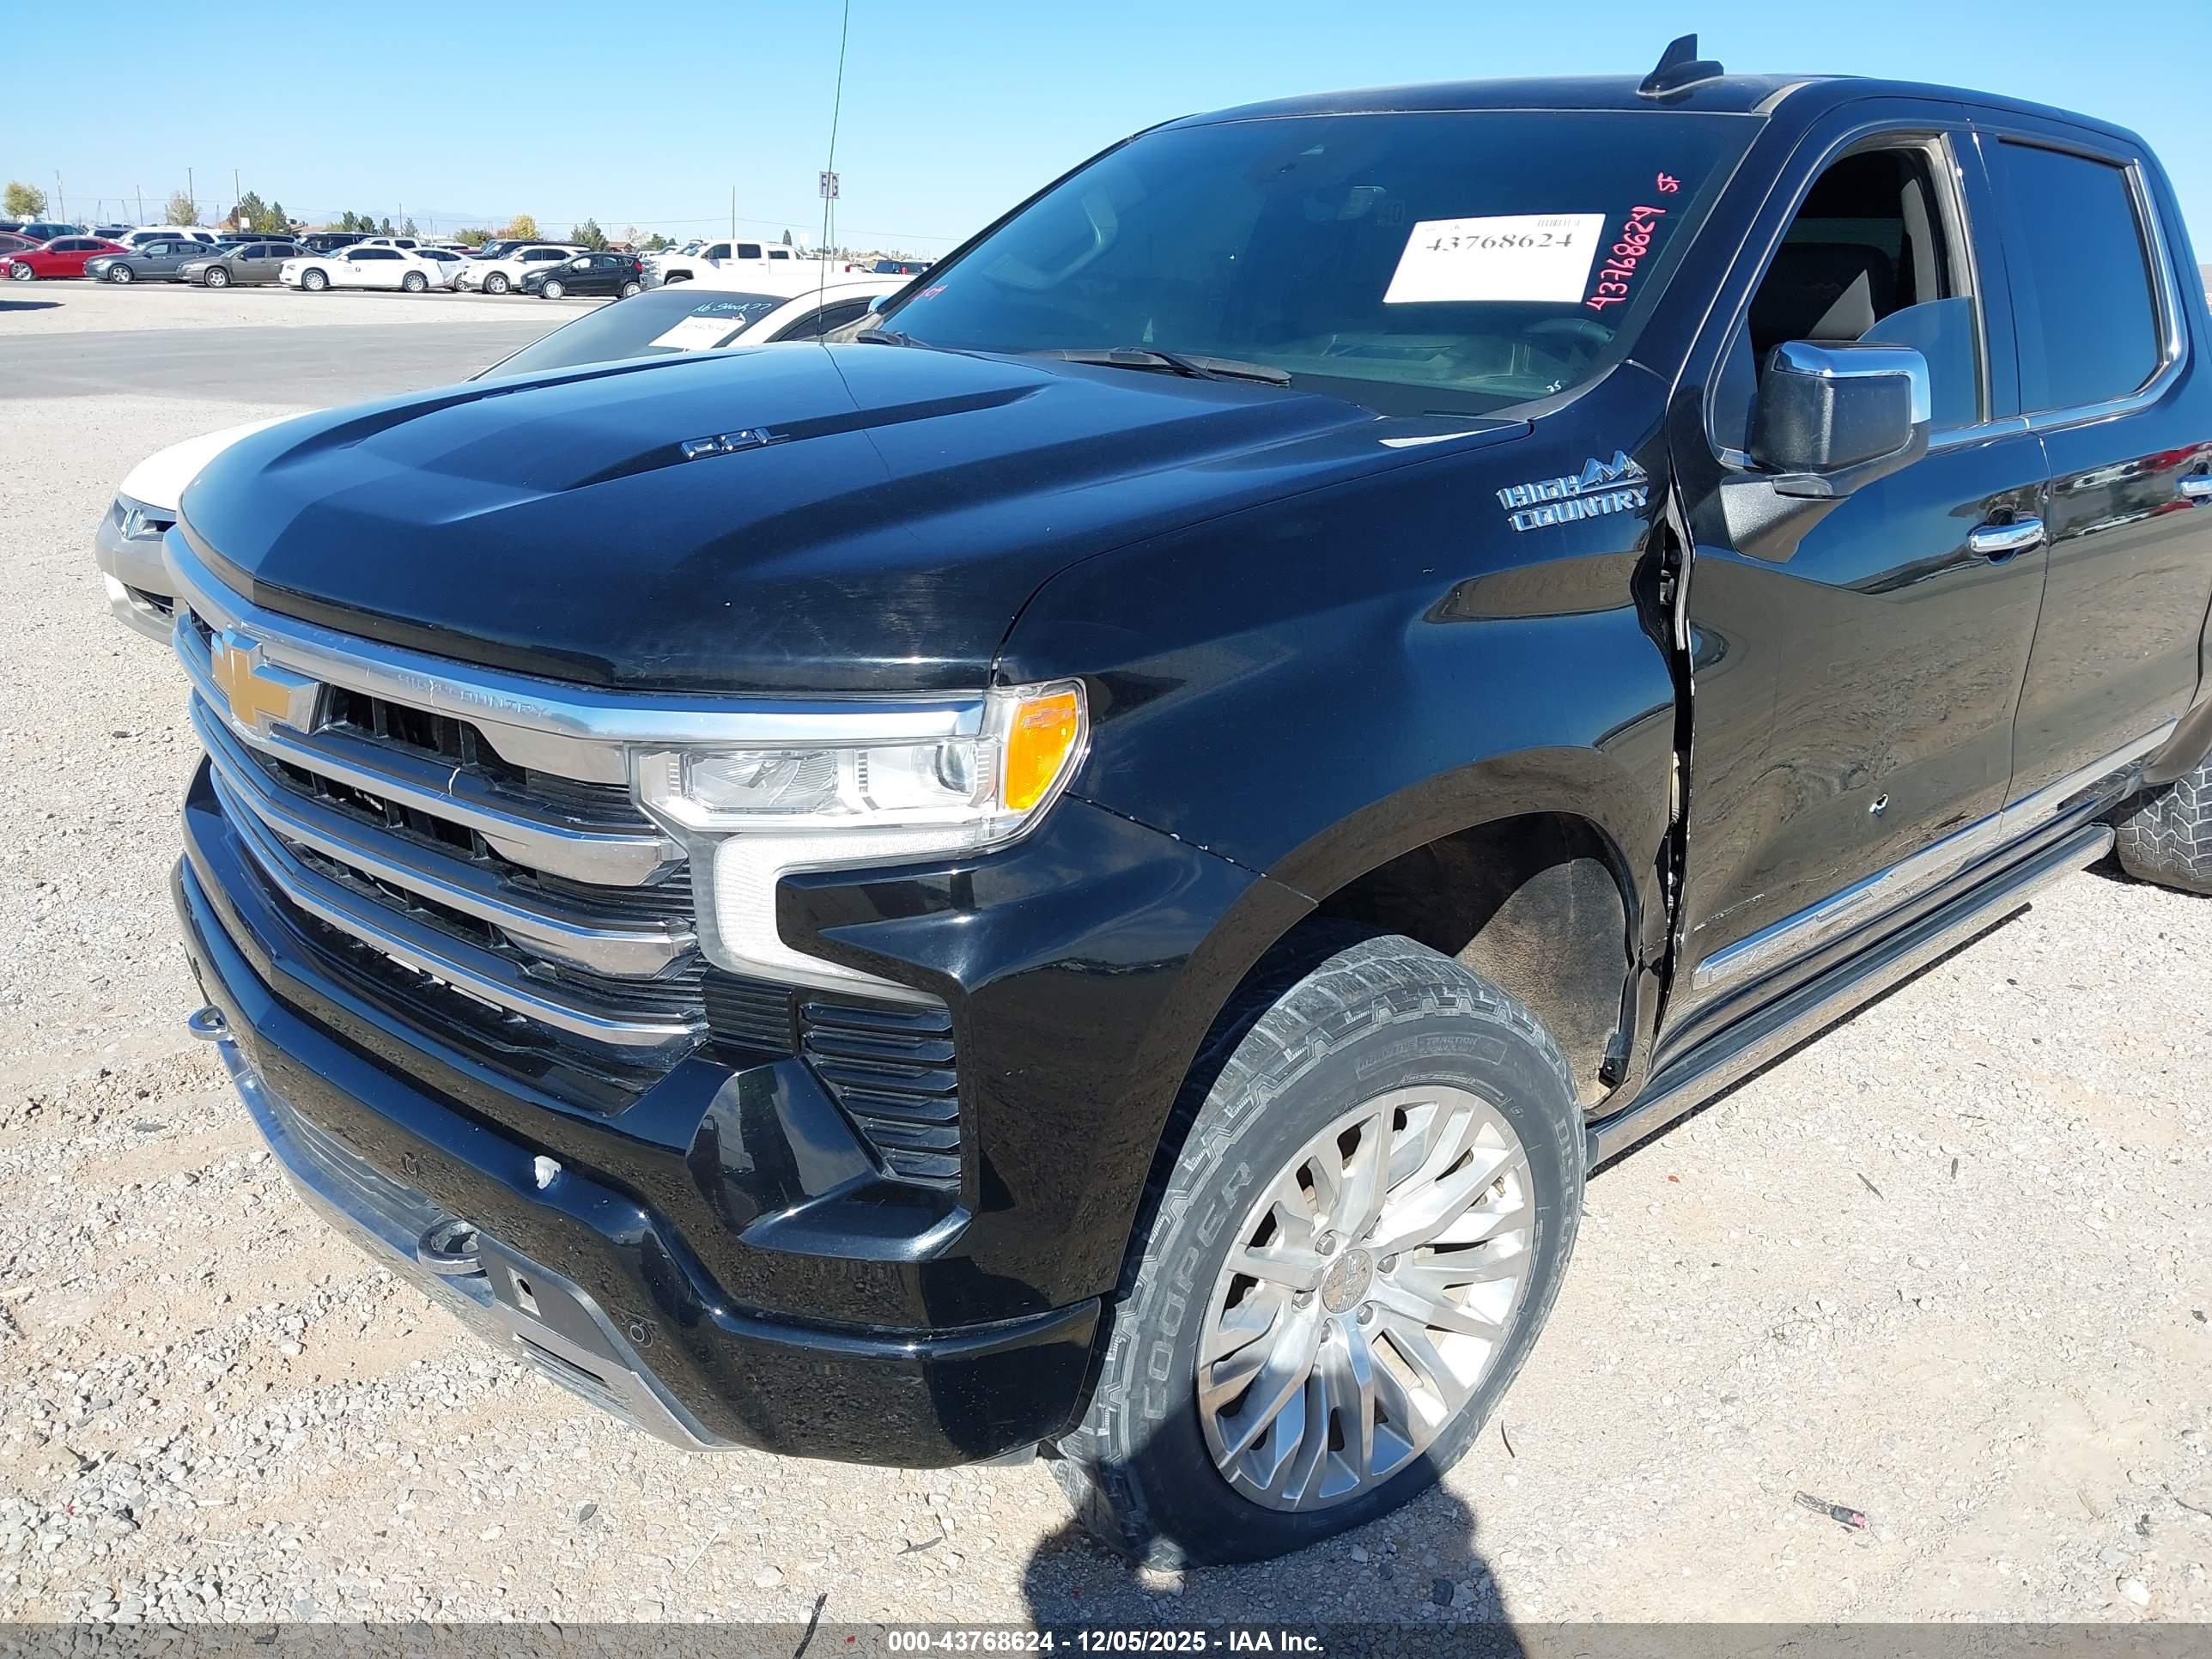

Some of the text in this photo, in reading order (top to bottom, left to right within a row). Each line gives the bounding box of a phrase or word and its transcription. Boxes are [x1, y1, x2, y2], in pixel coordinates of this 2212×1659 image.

[1425, 233, 1573, 252] 43768624
[1586, 206, 1666, 310] 43768624
[1496, 475, 1584, 511] HIGH
[1508, 486, 1650, 532] COUNTRY
[1144, 1153, 1255, 1419] COOPER
